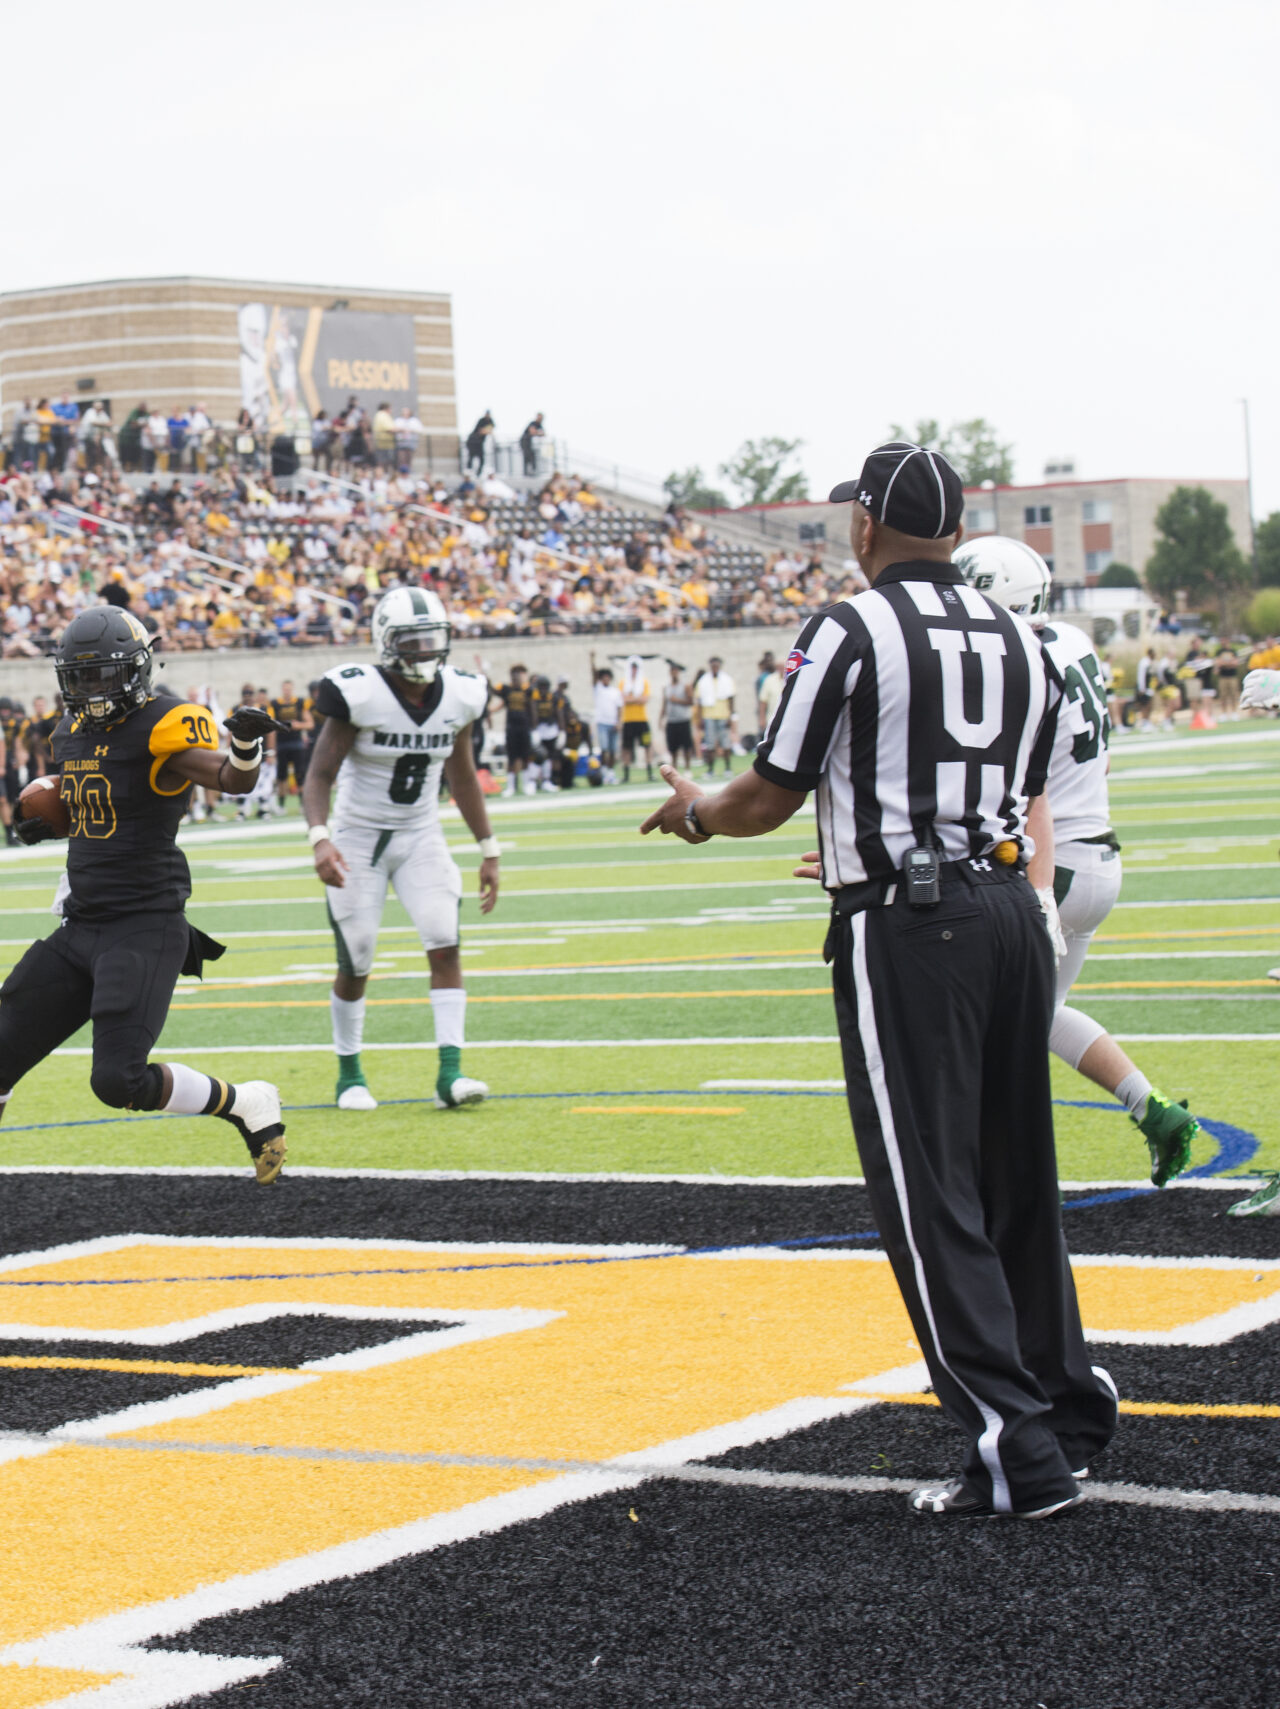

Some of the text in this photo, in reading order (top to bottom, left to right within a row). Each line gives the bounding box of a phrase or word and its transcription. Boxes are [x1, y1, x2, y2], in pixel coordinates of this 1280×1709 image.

[327, 359, 410, 392] PASSION
[926, 627, 1008, 750] U
[181, 715, 213, 745] 30
[63, 759, 100, 771] BULLDOGS
